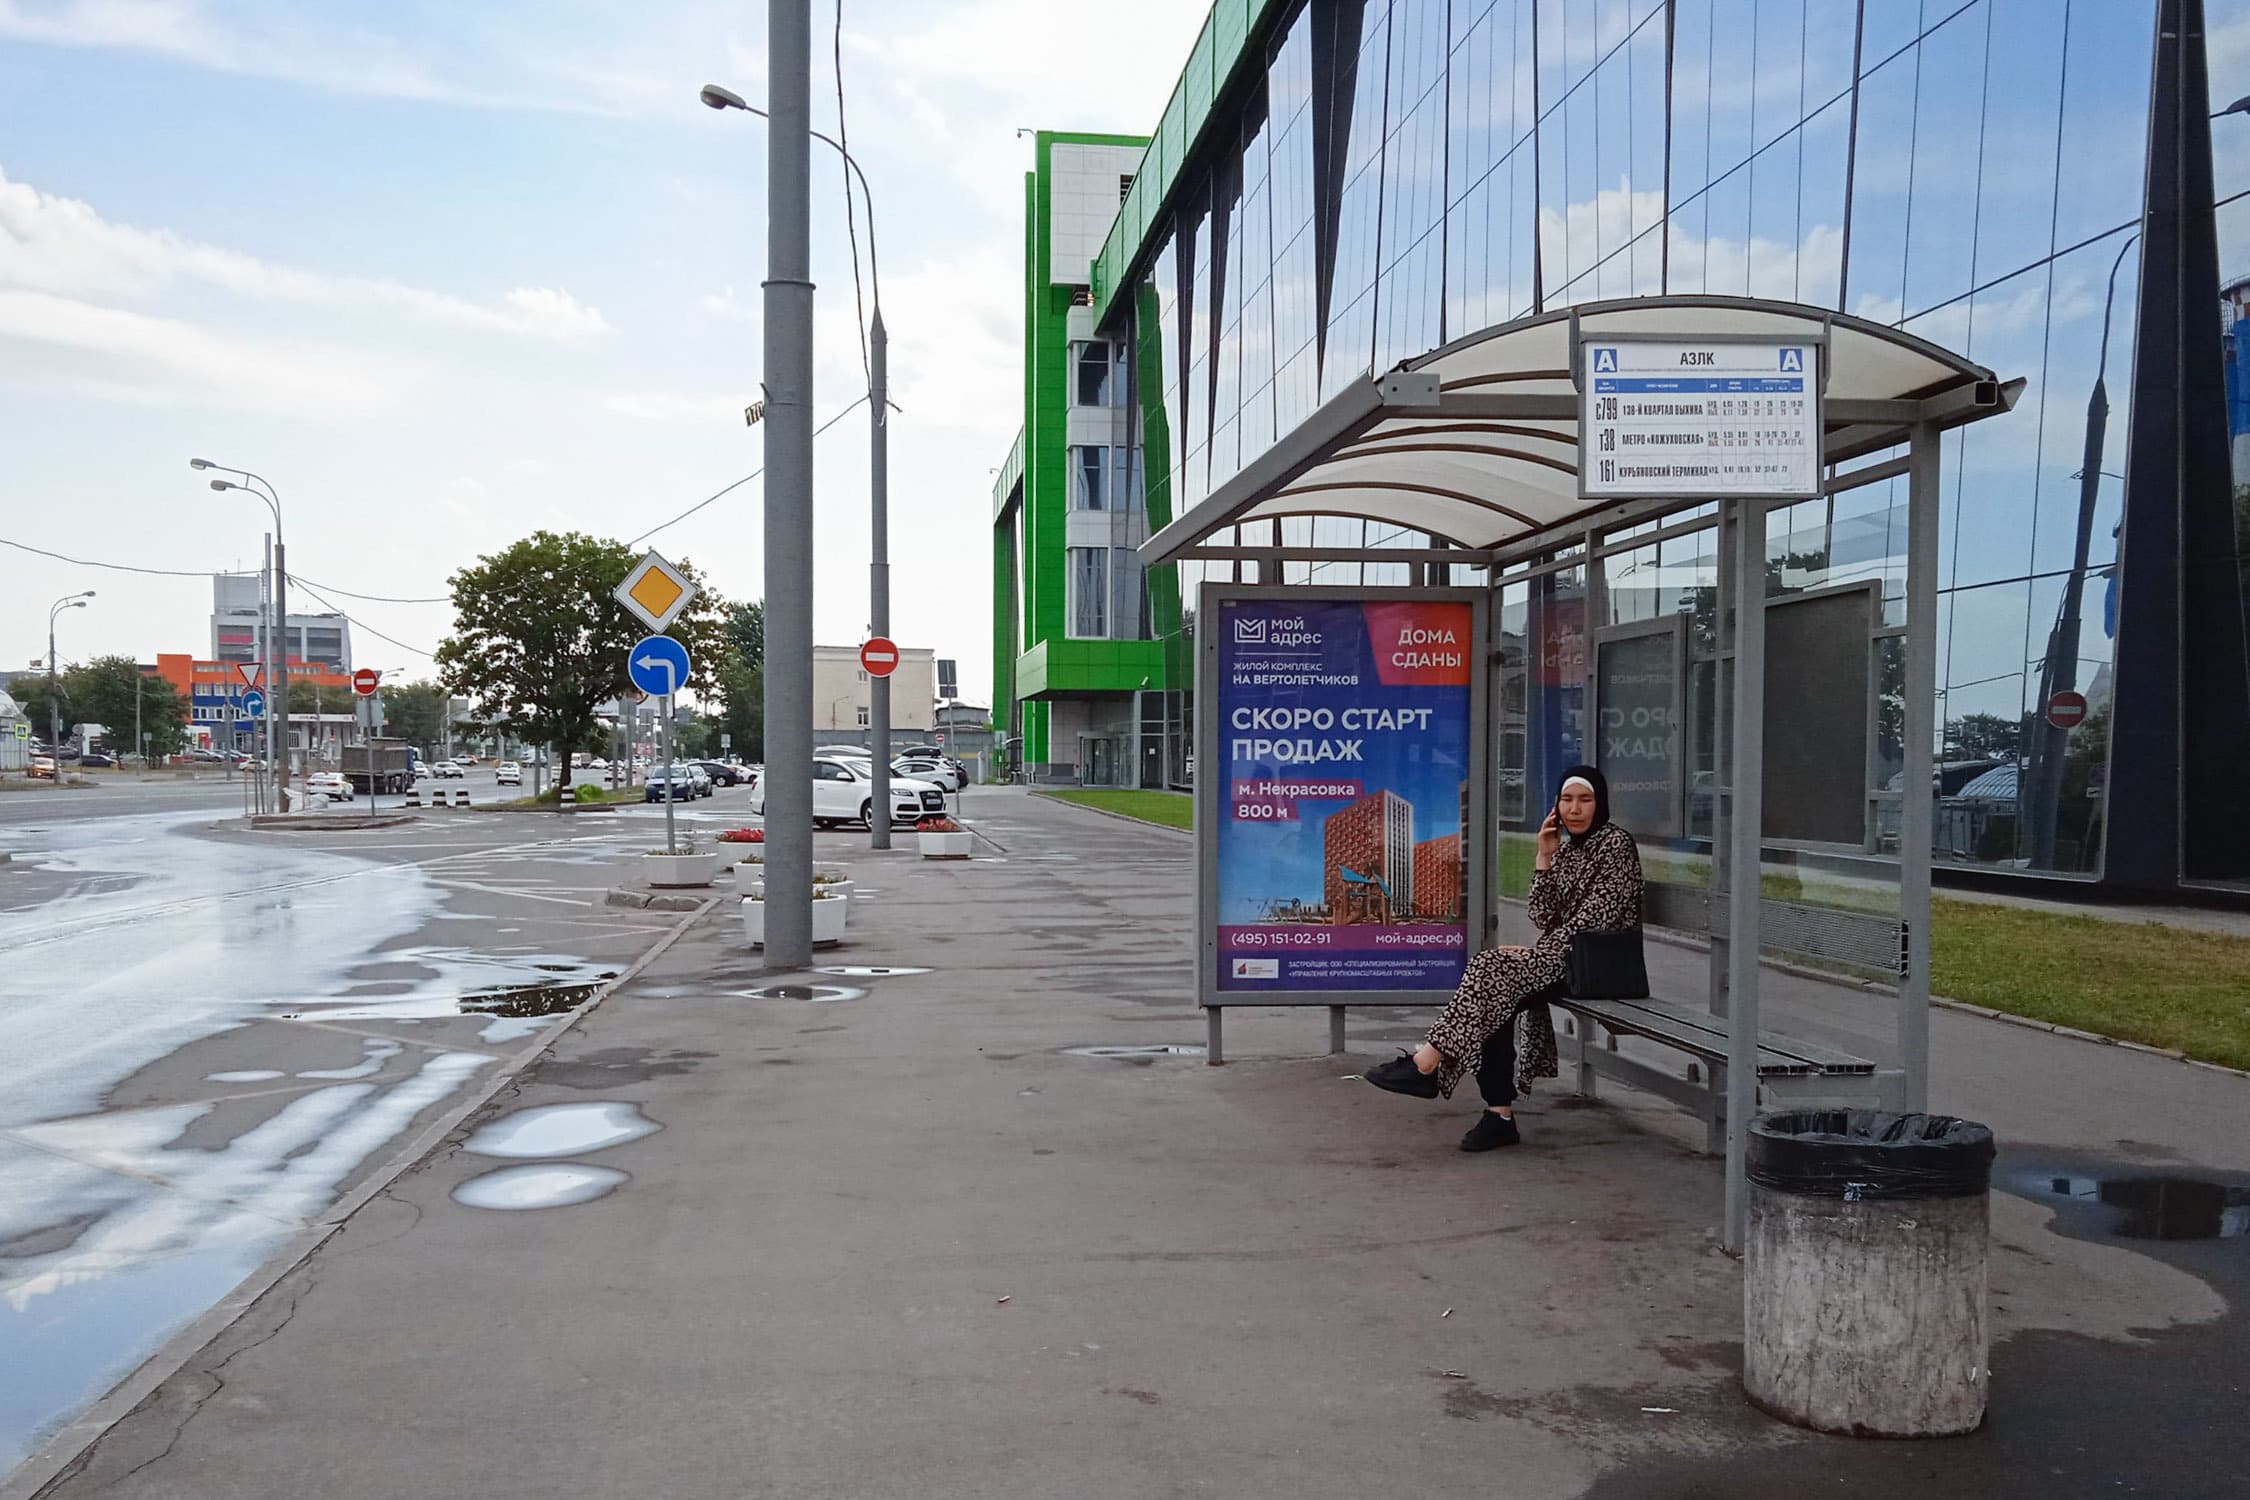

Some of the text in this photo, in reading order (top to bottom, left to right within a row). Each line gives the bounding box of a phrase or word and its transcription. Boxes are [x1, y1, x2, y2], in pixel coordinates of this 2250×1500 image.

[1680, 352, 1714, 366] АЗЛК
[1644, 404, 1674, 416] КВАРТАЛ
[1675, 404, 1703, 416] ВЫХИНА
[1599, 428, 1615, 451] т38
[1622, 434, 1645, 445] МЕТРО
[1600, 460, 1615, 482] 161
[1619, 465, 1709, 477] КУРЬЯНОВСКИЙ ТЕРМИНАЛ
[1271, 616, 1304, 630] мой
[1271, 631, 1322, 647] адрес
[1398, 629, 1456, 646] ДОМА
[1233, 661, 1322, 671] ЖИЛОЙ КОМПЛЕКС
[1392, 652, 1461, 668] СДАНЫ
[1233, 675, 1359, 686] НА ВЕРТОЛЕТЧИКОВ
[1232, 707, 1433, 730] СКОРО СТАРТ
[1232, 739, 1363, 764] ПРОДАЖ
[1239, 781, 1355, 798] м. Некрасовка
[1238, 804, 1288, 818] 800 м
[1231, 933, 1331, 946] (495) 151-02-91
[1375, 932, 1464, 946] мой-адрес.рф
